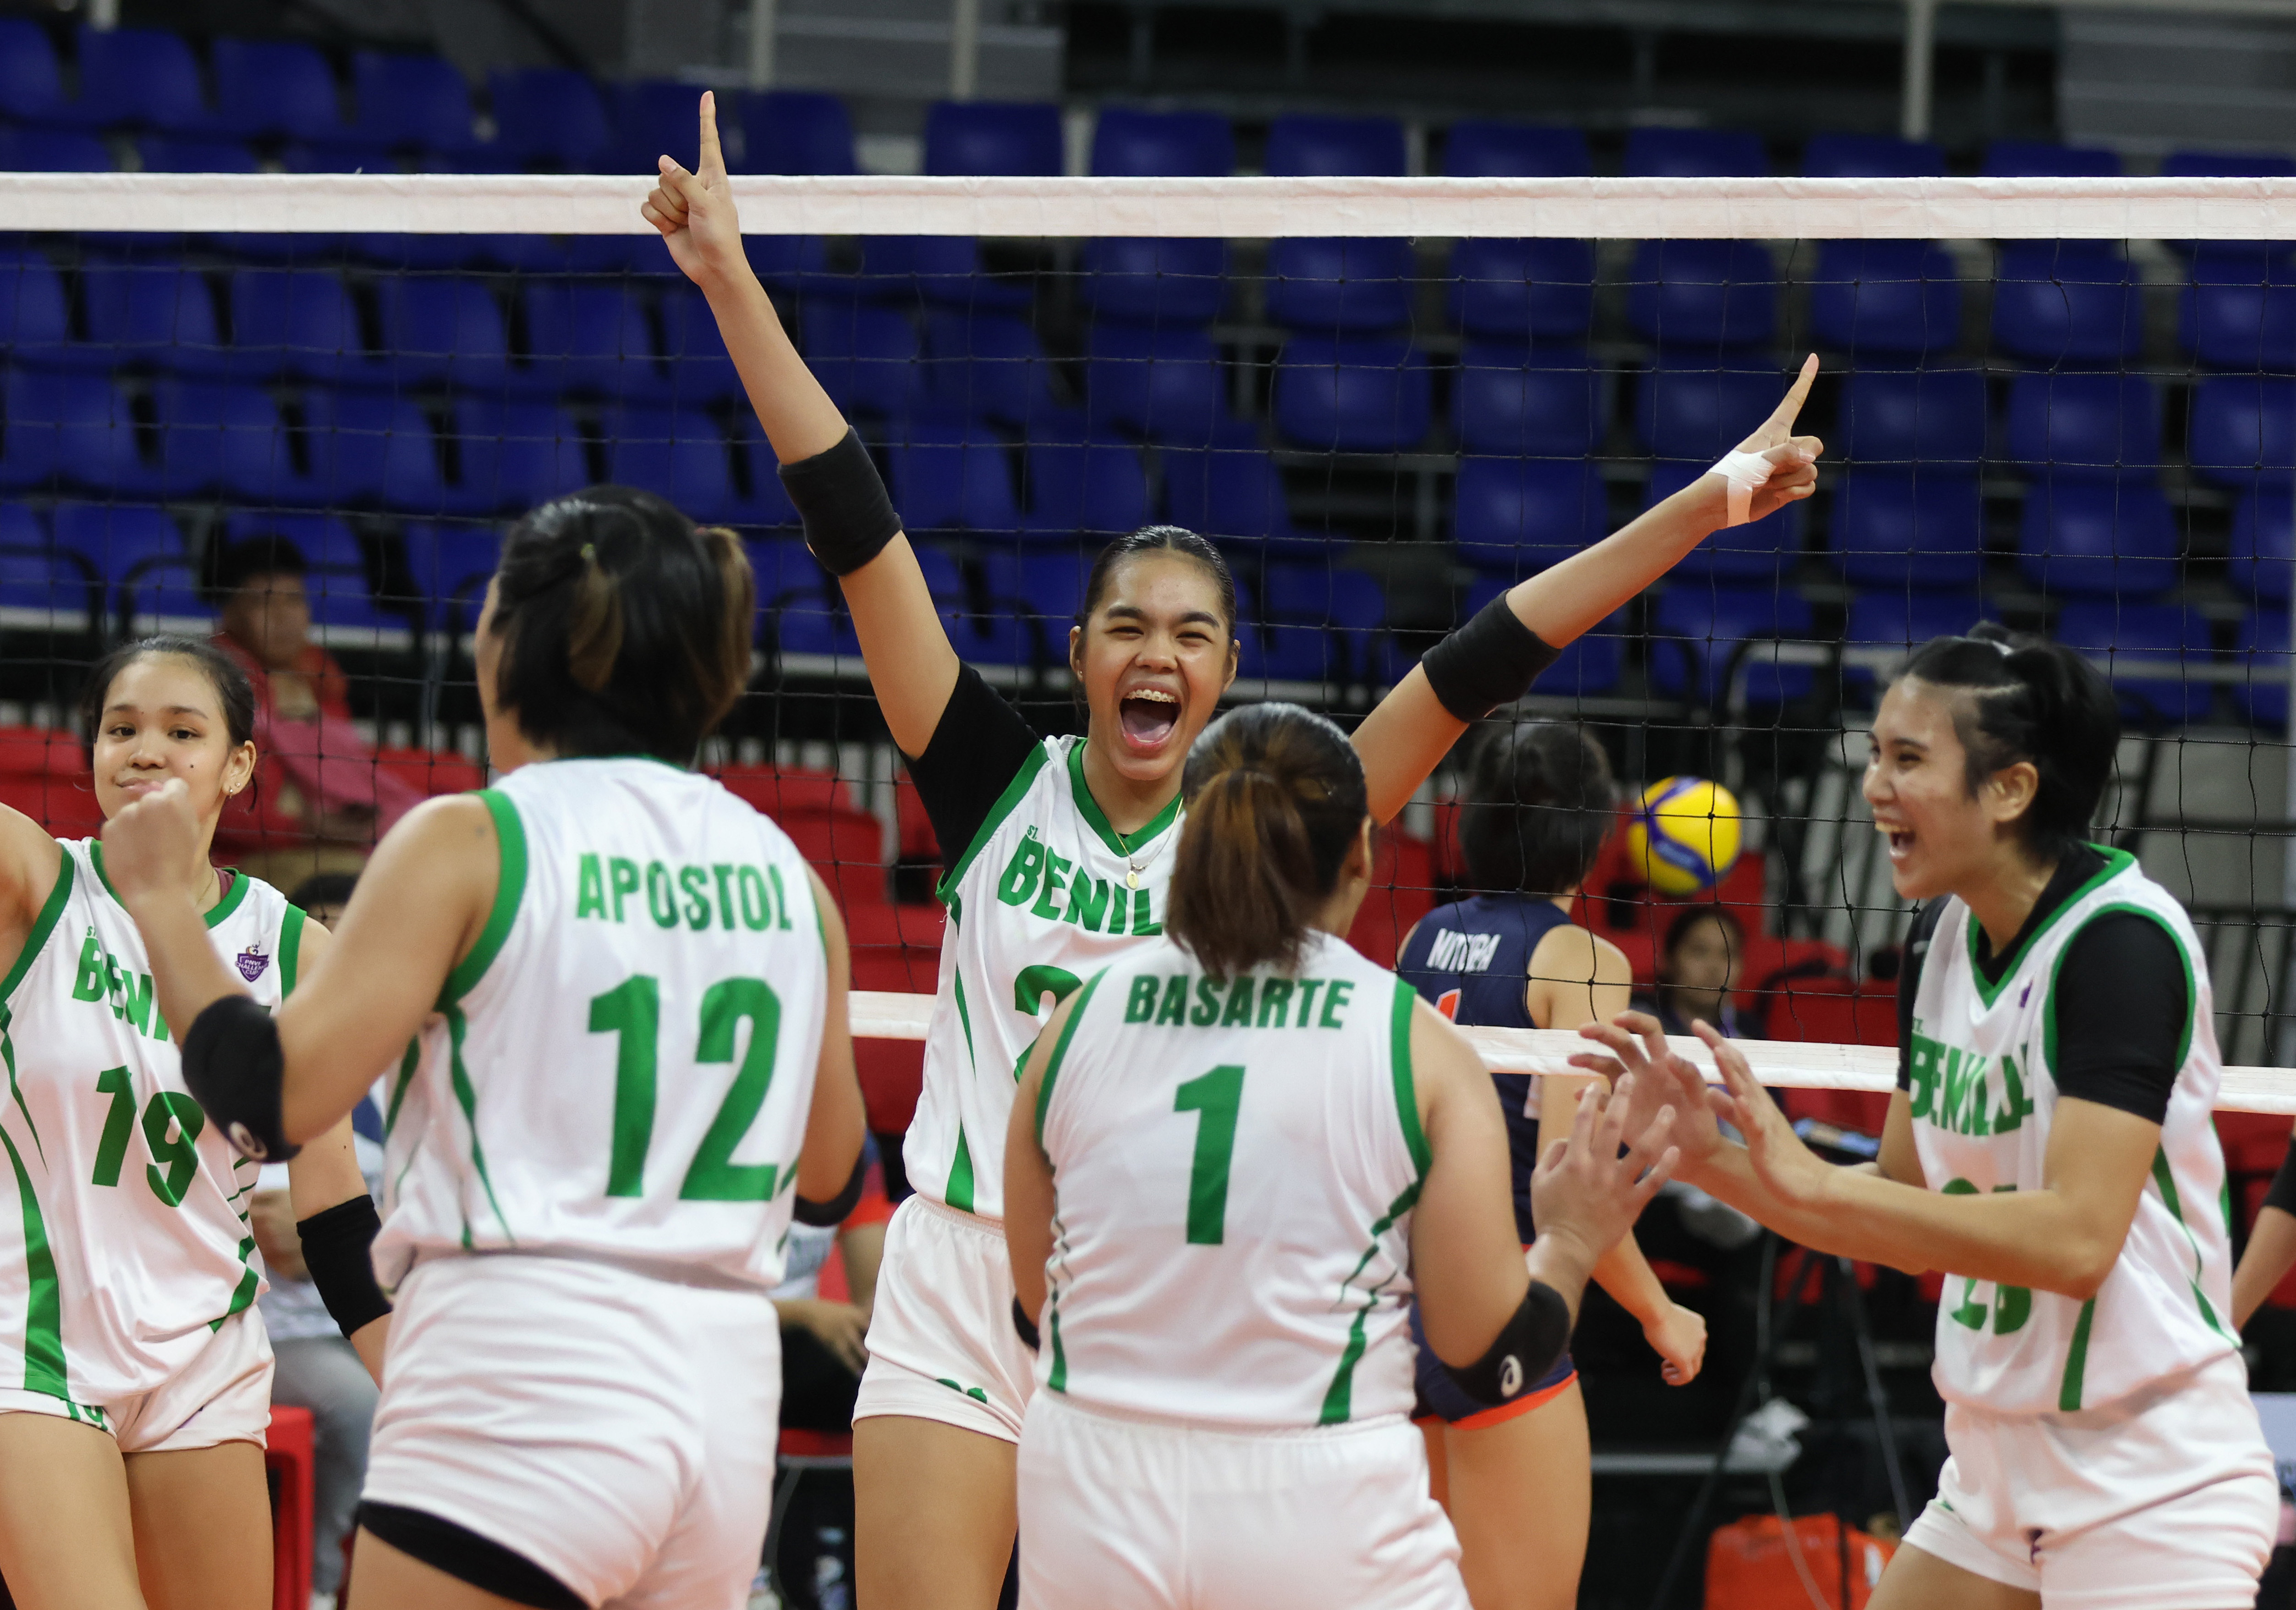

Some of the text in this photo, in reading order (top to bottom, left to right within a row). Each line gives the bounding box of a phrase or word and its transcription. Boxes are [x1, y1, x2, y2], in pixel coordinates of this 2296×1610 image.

[576, 852, 792, 931] APOSTOL
[997, 833, 1162, 936] BENIL
[235, 961, 269, 970] CHALLEN
[1124, 974, 1355, 1030] BASARTE
[91, 1064, 204, 1207] 19
[587, 974, 780, 1200] 12
[1173, 1064, 1246, 1244] 1
